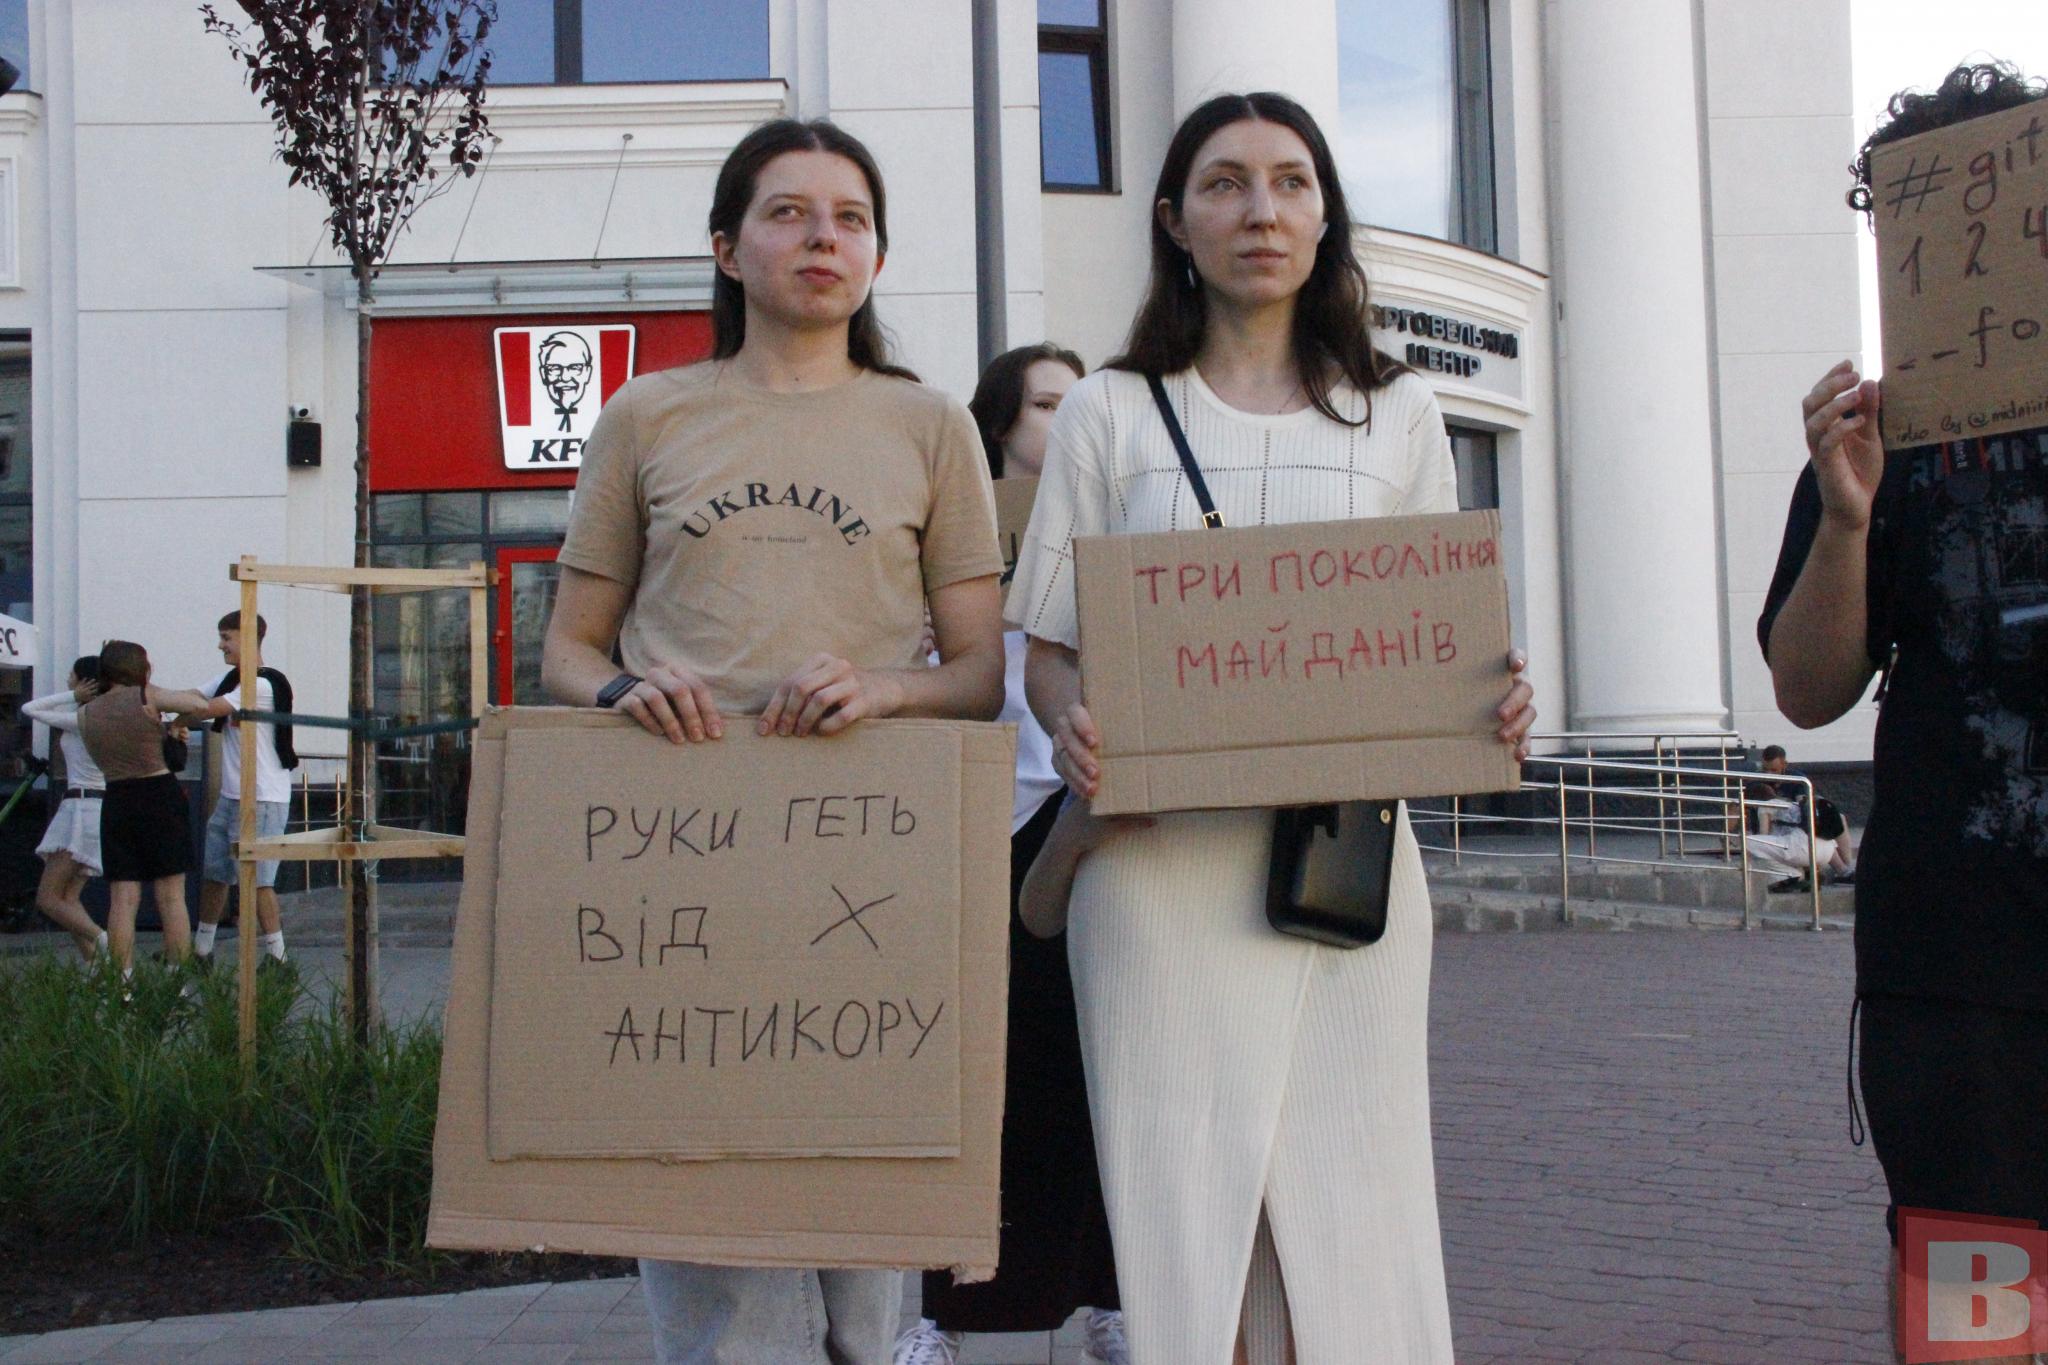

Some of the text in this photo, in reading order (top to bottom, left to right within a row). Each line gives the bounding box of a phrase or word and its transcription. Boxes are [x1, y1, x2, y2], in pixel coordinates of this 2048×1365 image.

[1406, 342, 1482, 378] ЦЕНТР
[528, 438, 588, 463] KF
[680, 482, 871, 546] UKRAINE
[1135, 560, 1241, 604] ТРИ
[585, 795, 916, 862] РУКИ ГЕТЬ
[577, 898, 708, 968] ВІД
[604, 998, 944, 1067] АНТИКОРУ
